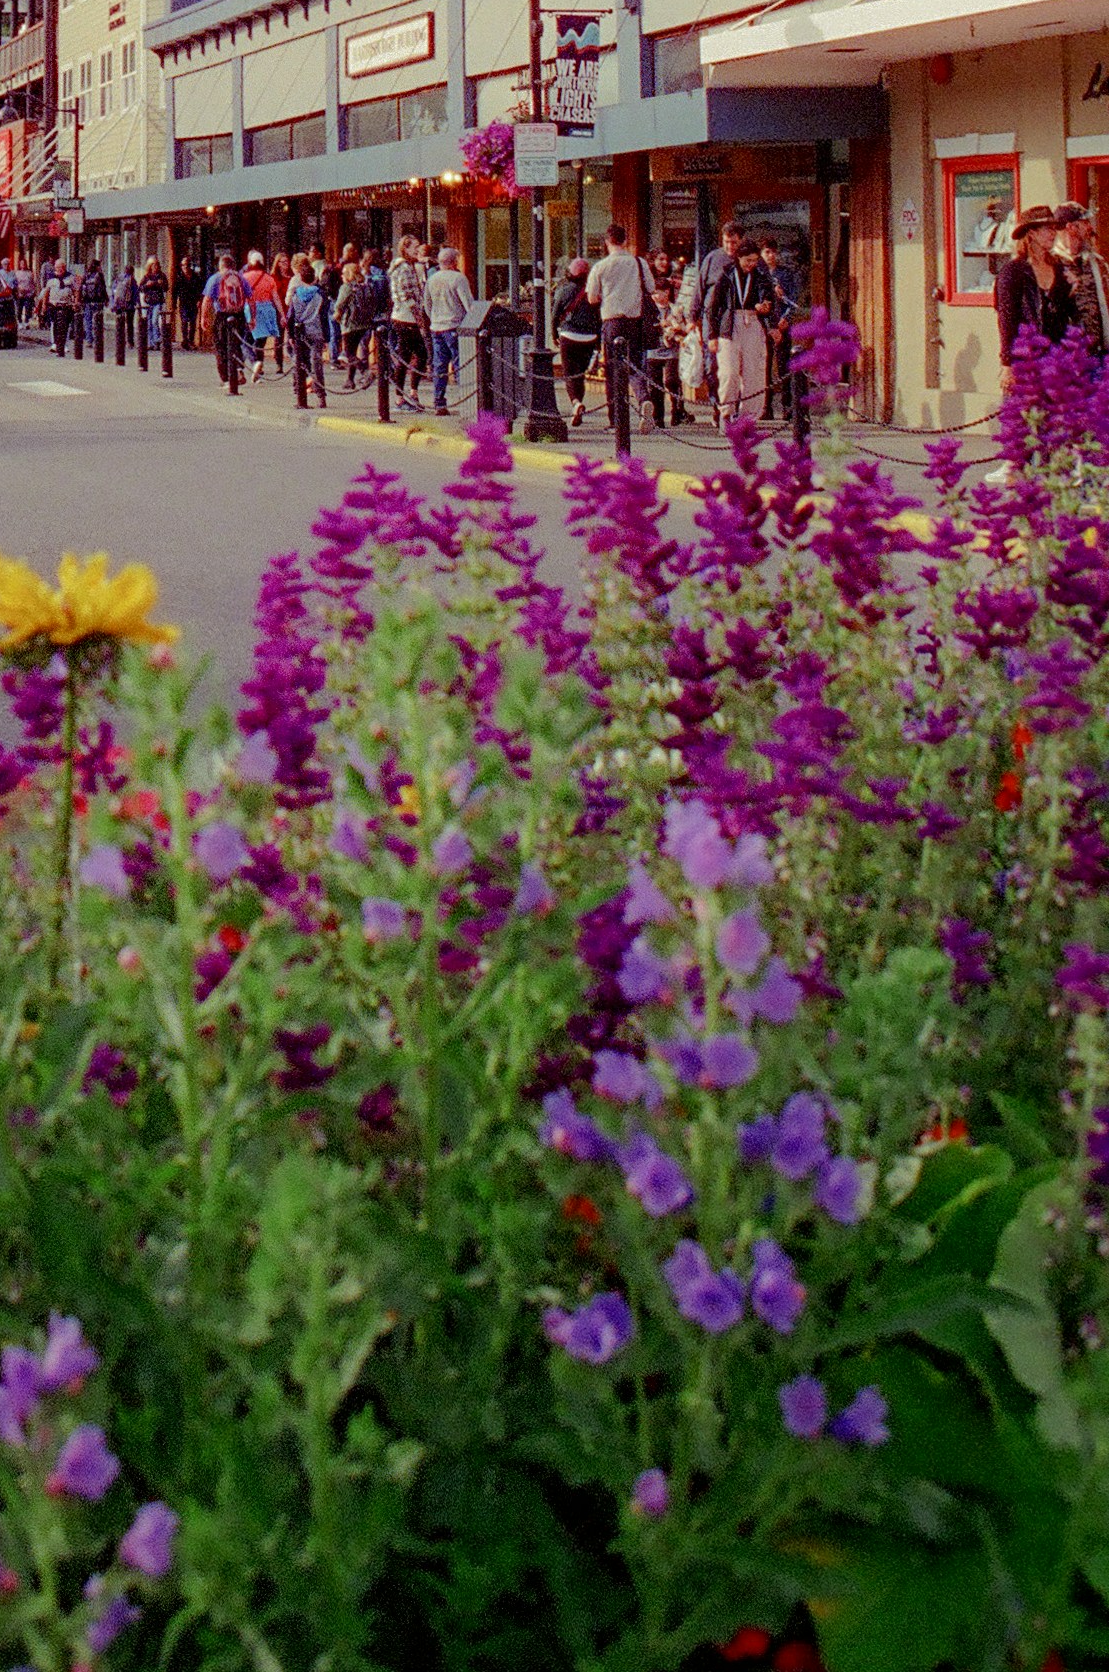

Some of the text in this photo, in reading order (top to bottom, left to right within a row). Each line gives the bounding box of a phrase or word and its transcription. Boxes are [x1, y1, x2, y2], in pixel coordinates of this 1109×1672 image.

[556, 59, 599, 78] WE ARE
[549, 88, 597, 109] LIGHTS
[549, 106, 596, 124] CHASERS
